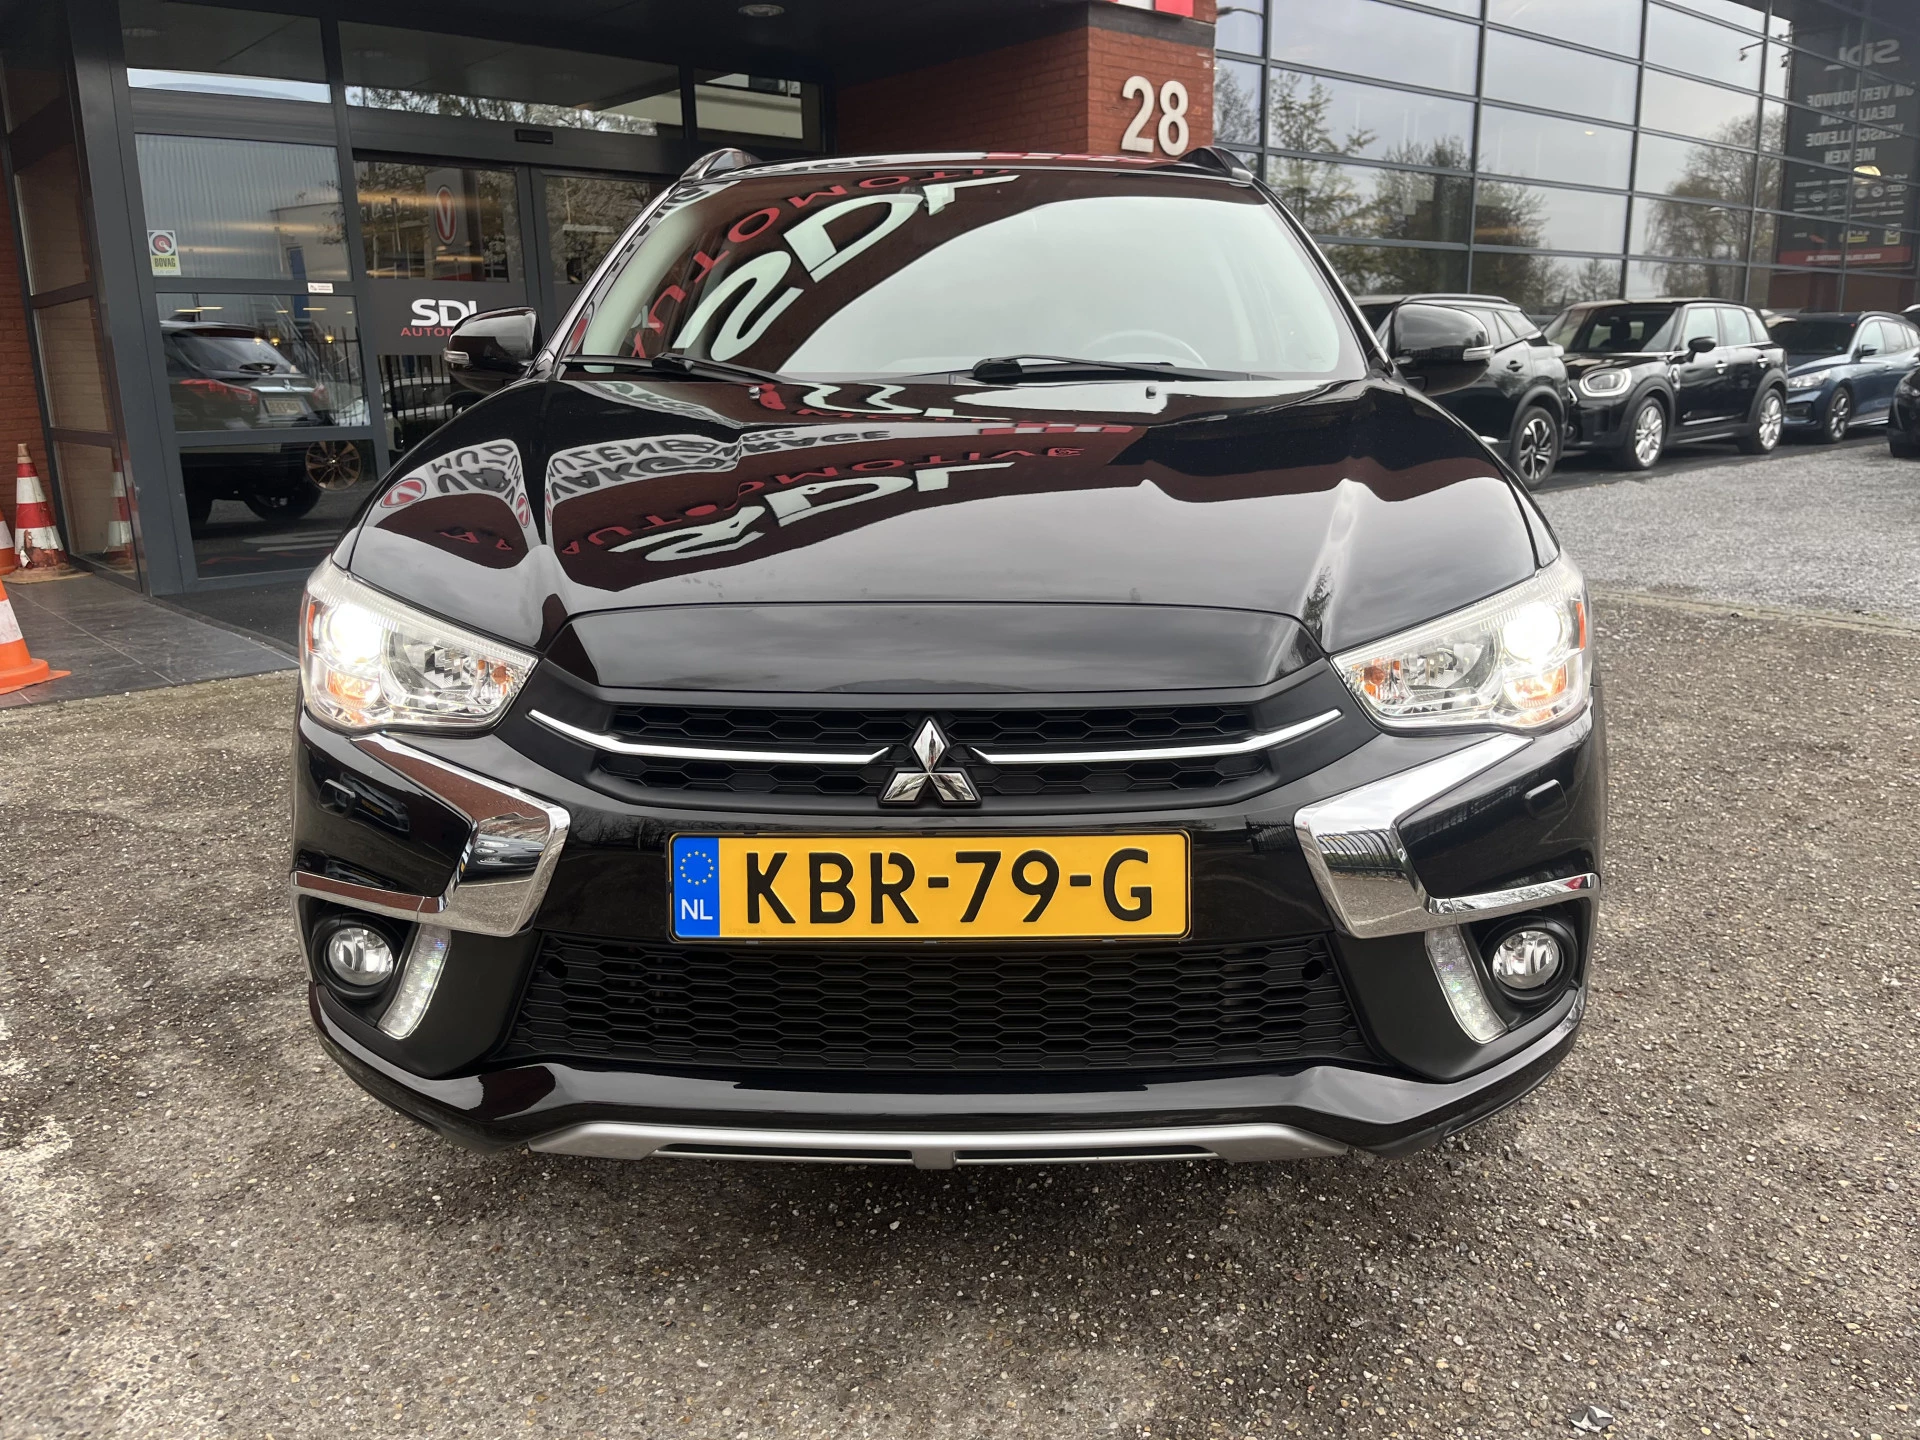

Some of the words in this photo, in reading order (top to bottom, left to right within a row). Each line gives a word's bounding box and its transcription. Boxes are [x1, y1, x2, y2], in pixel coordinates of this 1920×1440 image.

[1121, 75, 1190, 156] 28
[154, 257, 176, 268] BOVAG
[681, 898, 713, 921] NL
[746, 847, 1153, 924] KBR-79-G
